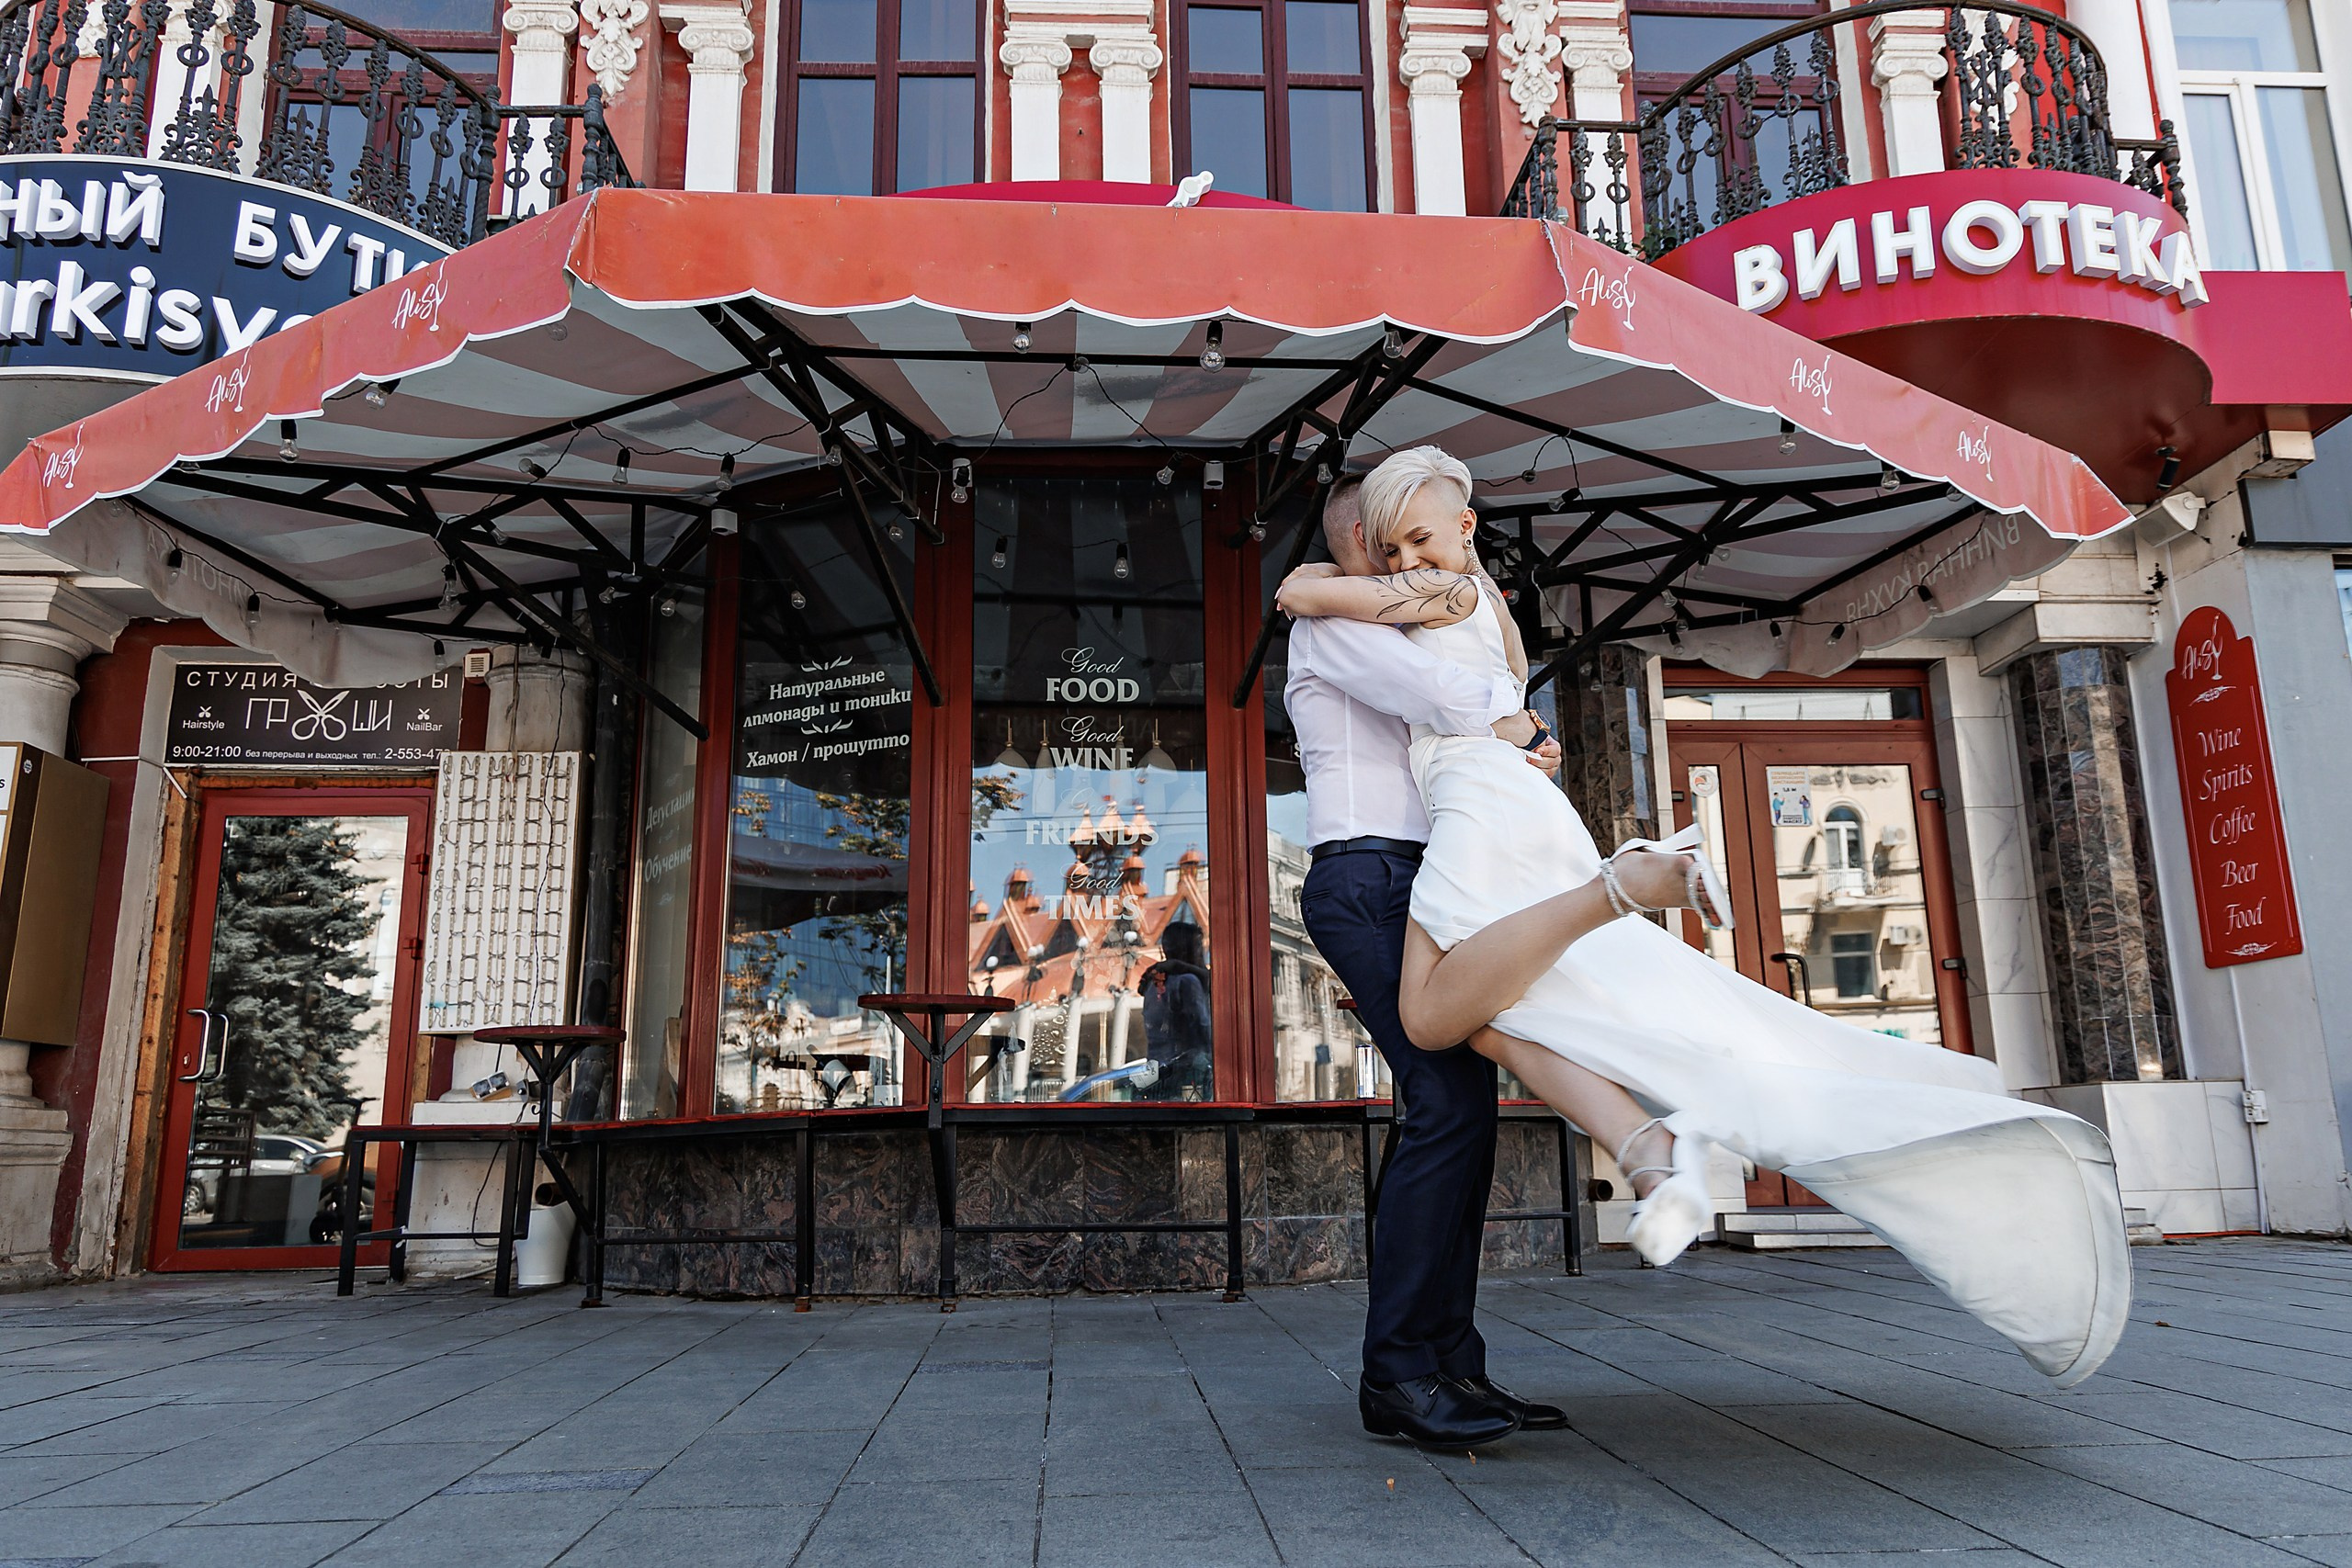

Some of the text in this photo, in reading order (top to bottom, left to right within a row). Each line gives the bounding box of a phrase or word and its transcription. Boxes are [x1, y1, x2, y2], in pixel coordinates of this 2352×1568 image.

[1732, 199, 2210, 315] ВИНОТЕКА
[0, 261, 314, 357] rkisy
[1061, 647, 1124, 674] Good
[187, 671, 298, 690] СТУДИЯ
[769, 670, 886, 700] Натуральные
[1046, 677, 1141, 703] FOOD
[830, 701, 840, 713] и
[844, 688, 911, 712] тоники
[183, 720, 225, 730] Hairstyle
[406, 722, 443, 731] NailBar
[1061, 716, 1125, 743] Good
[173, 745, 242, 758] 9:00-21:00
[245, 750, 261, 758] без
[262, 751, 305, 760] перерыва
[384, 748, 450, 760] 2-553-47
[746, 750, 797, 768] Хамон
[813, 734, 910, 761] прошутто
[2198, 727, 2242, 757] Wine
[1050, 747, 1136, 772] WINE
[2199, 762, 2254, 802] Spirits
[1025, 820, 1160, 846] FRIENDS
[2209, 806, 2256, 845] Coffee
[645, 843, 692, 884] Обучение
[1060, 862, 1124, 890] Good
[2220, 860, 2258, 888] Beer
[1044, 894, 1141, 920] TIMES
[2224, 897, 2267, 935] Food
